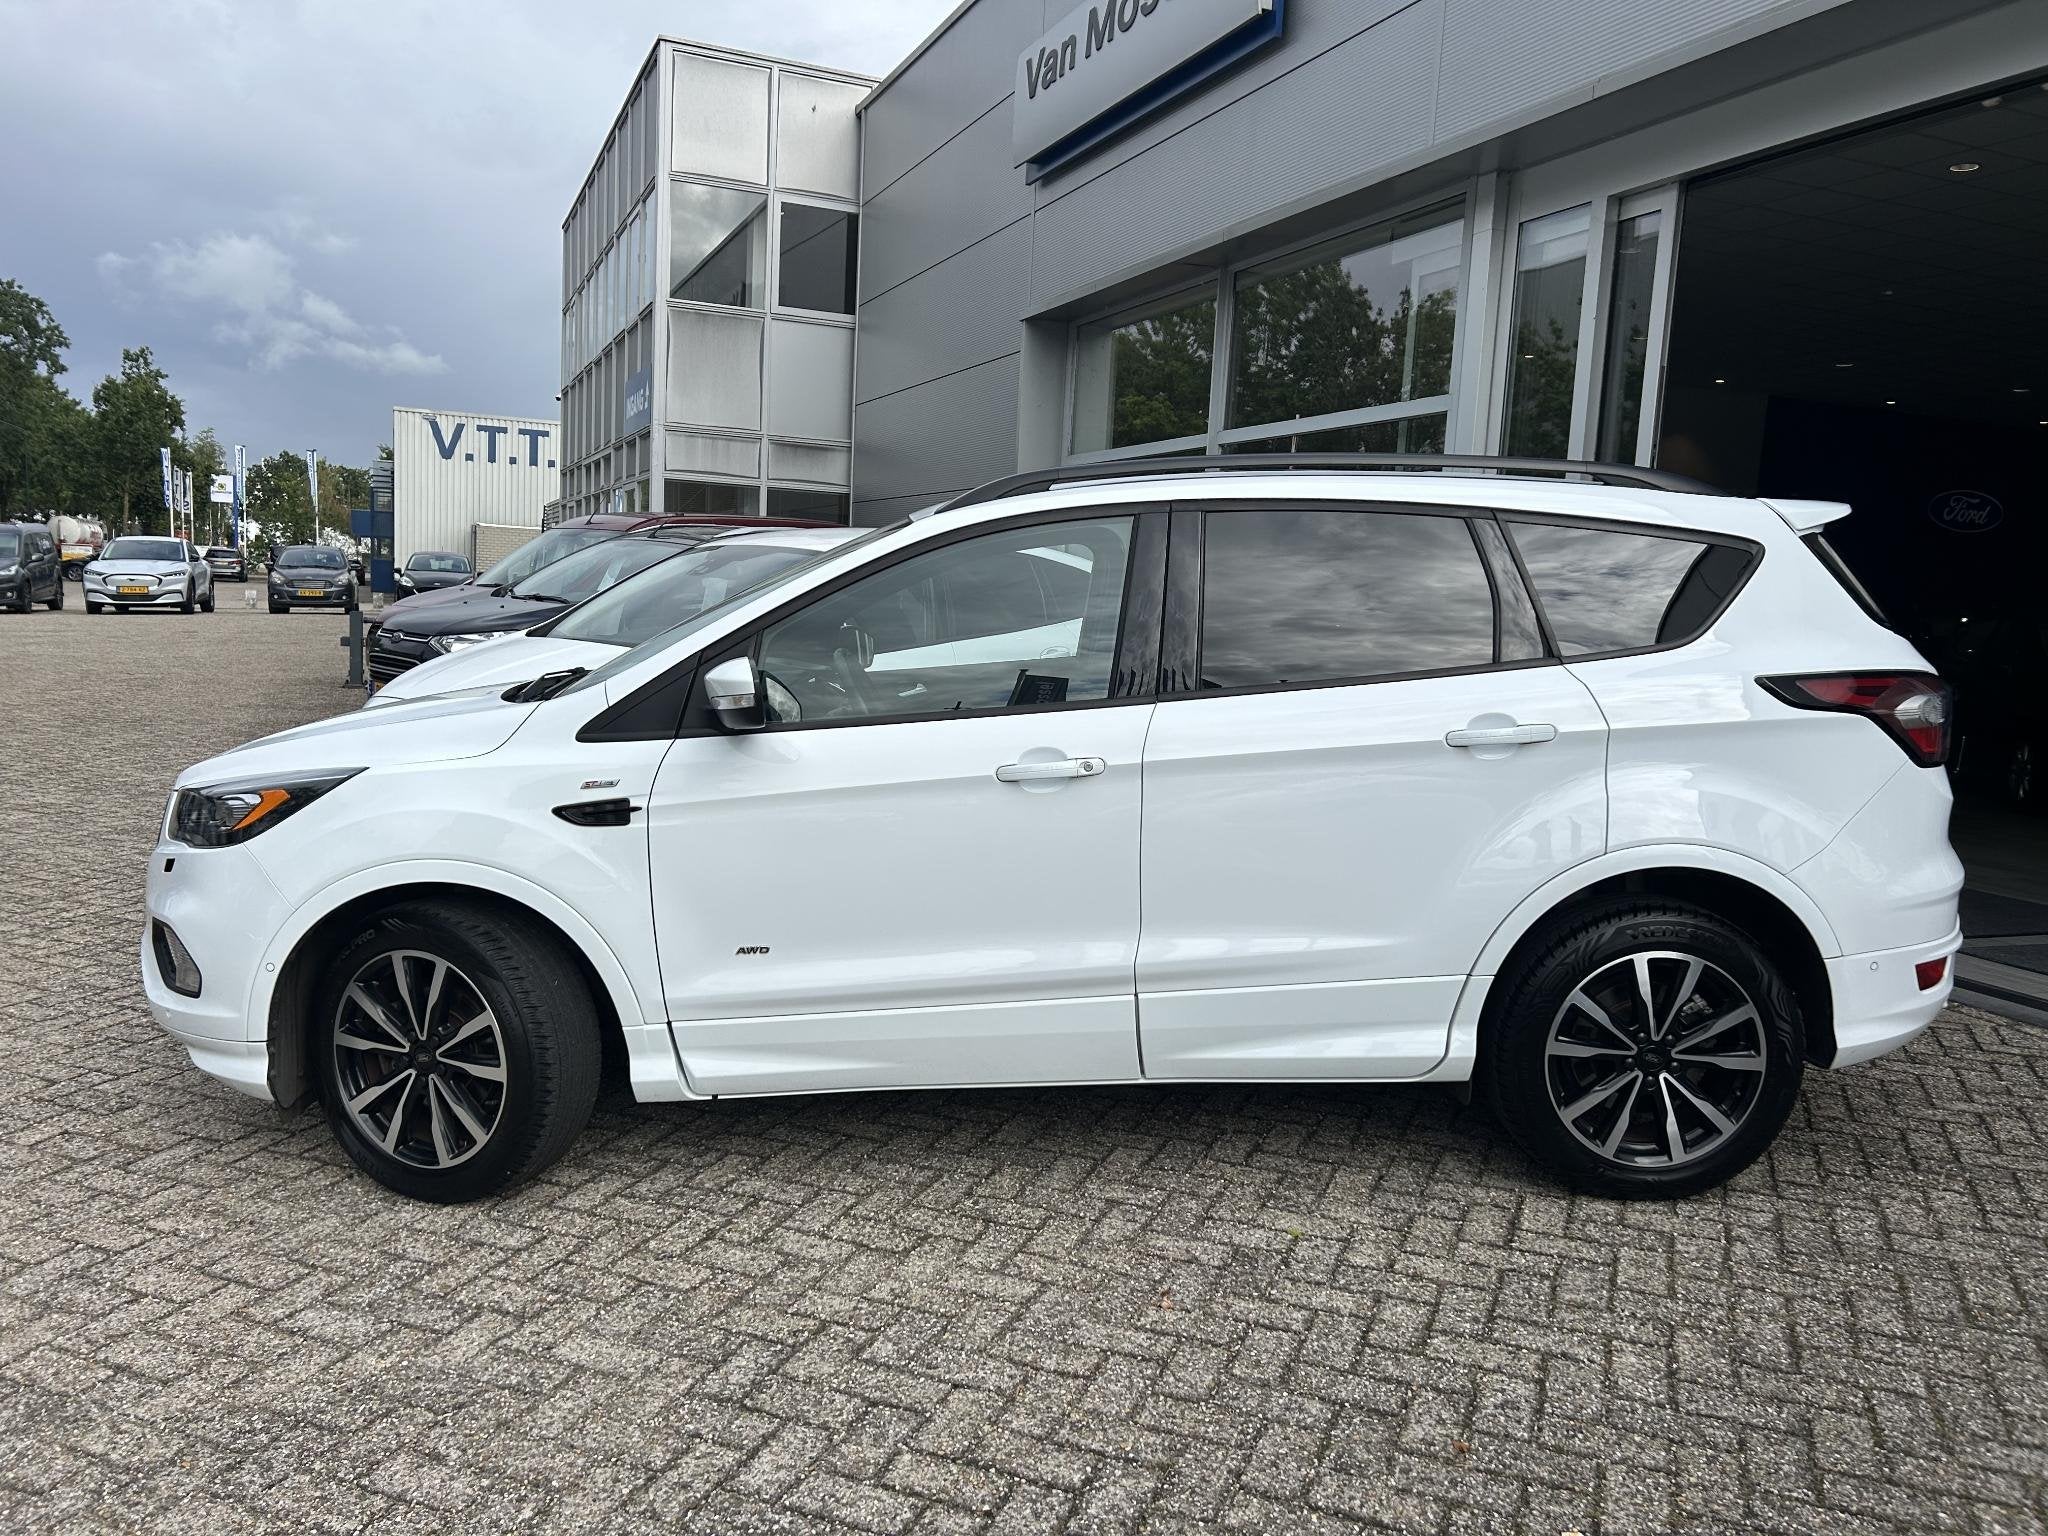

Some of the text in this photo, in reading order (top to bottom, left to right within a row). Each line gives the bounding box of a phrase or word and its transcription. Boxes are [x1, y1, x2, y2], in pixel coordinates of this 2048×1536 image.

[1026, 34, 1076, 99] Van
[1943, 495, 1991, 525] Ford
[735, 946, 770, 955] AWD
